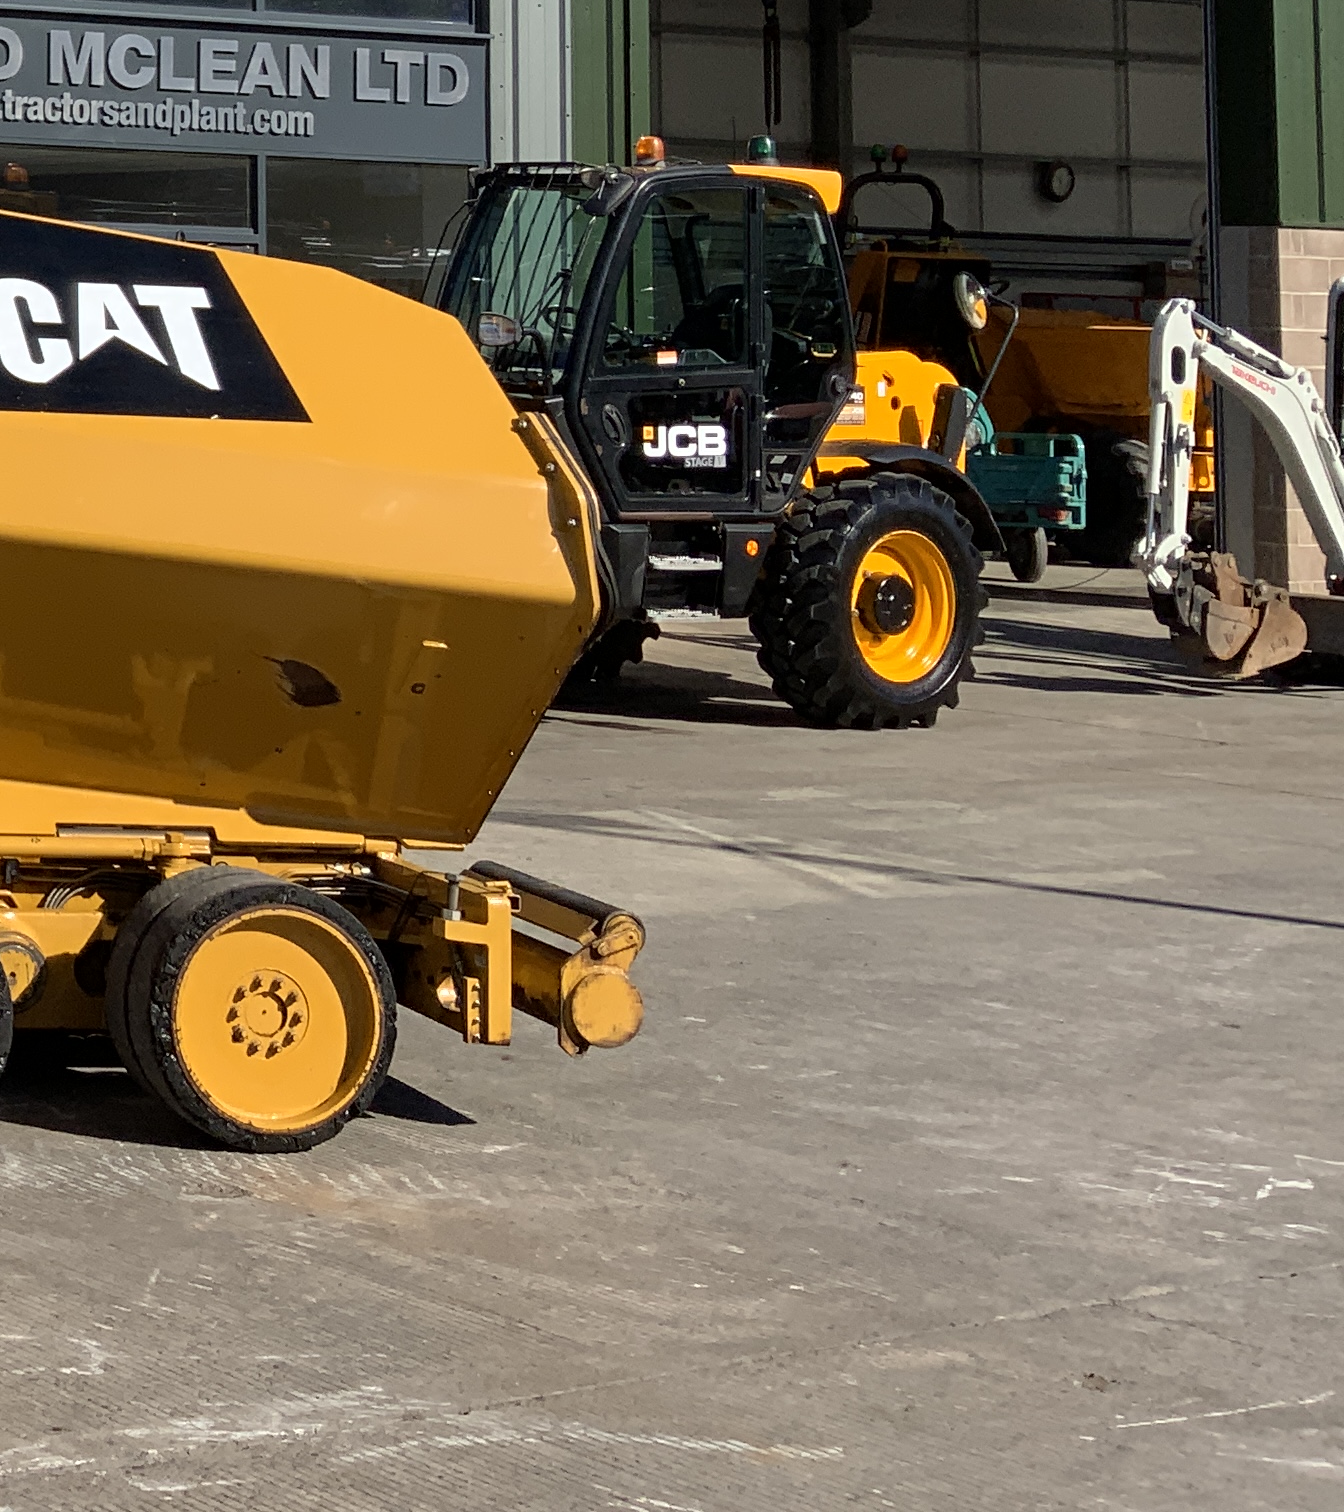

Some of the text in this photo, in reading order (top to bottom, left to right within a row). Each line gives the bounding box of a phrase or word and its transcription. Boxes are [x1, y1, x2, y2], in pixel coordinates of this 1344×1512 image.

[49, 29, 331, 98] MCLEAN
[354, 47, 470, 106] LTD
[643, 424, 727, 457] JCB
[684, 457, 714, 467] STAGE
